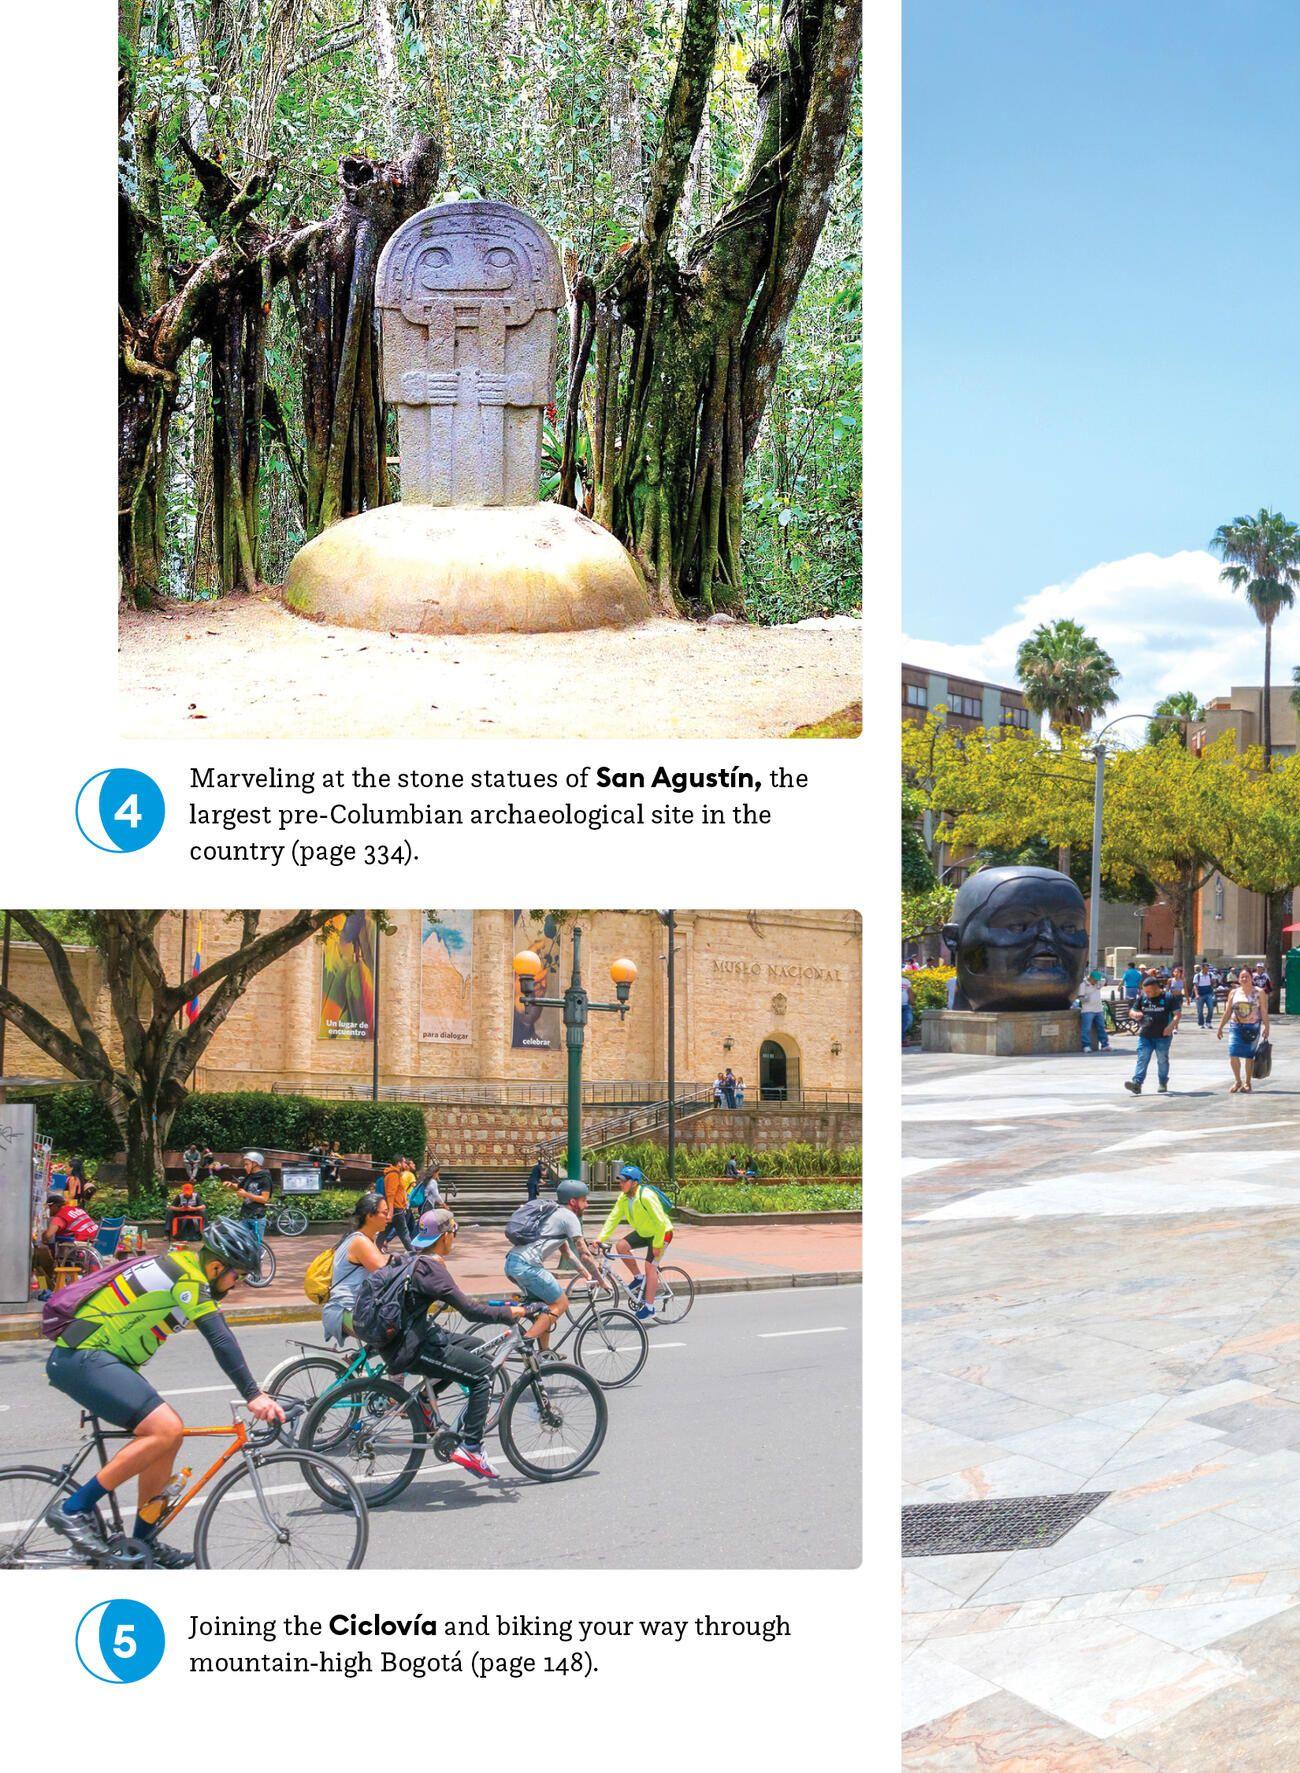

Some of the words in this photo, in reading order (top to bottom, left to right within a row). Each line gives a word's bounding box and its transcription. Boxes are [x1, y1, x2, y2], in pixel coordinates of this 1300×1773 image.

[712, 960, 761, 976] MUSEO
[767, 964, 843, 982] NACIONAL
[326, 1019, 337, 1027] Un
[338, 1020, 357, 1030] lugar
[359, 1021, 369, 1029] de
[328, 1028, 366, 1036] encuentro
[422, 1031, 439, 1039] para
[440, 1031, 469, 1041] dialogar
[522, 1037, 551, 1046] celebrar
